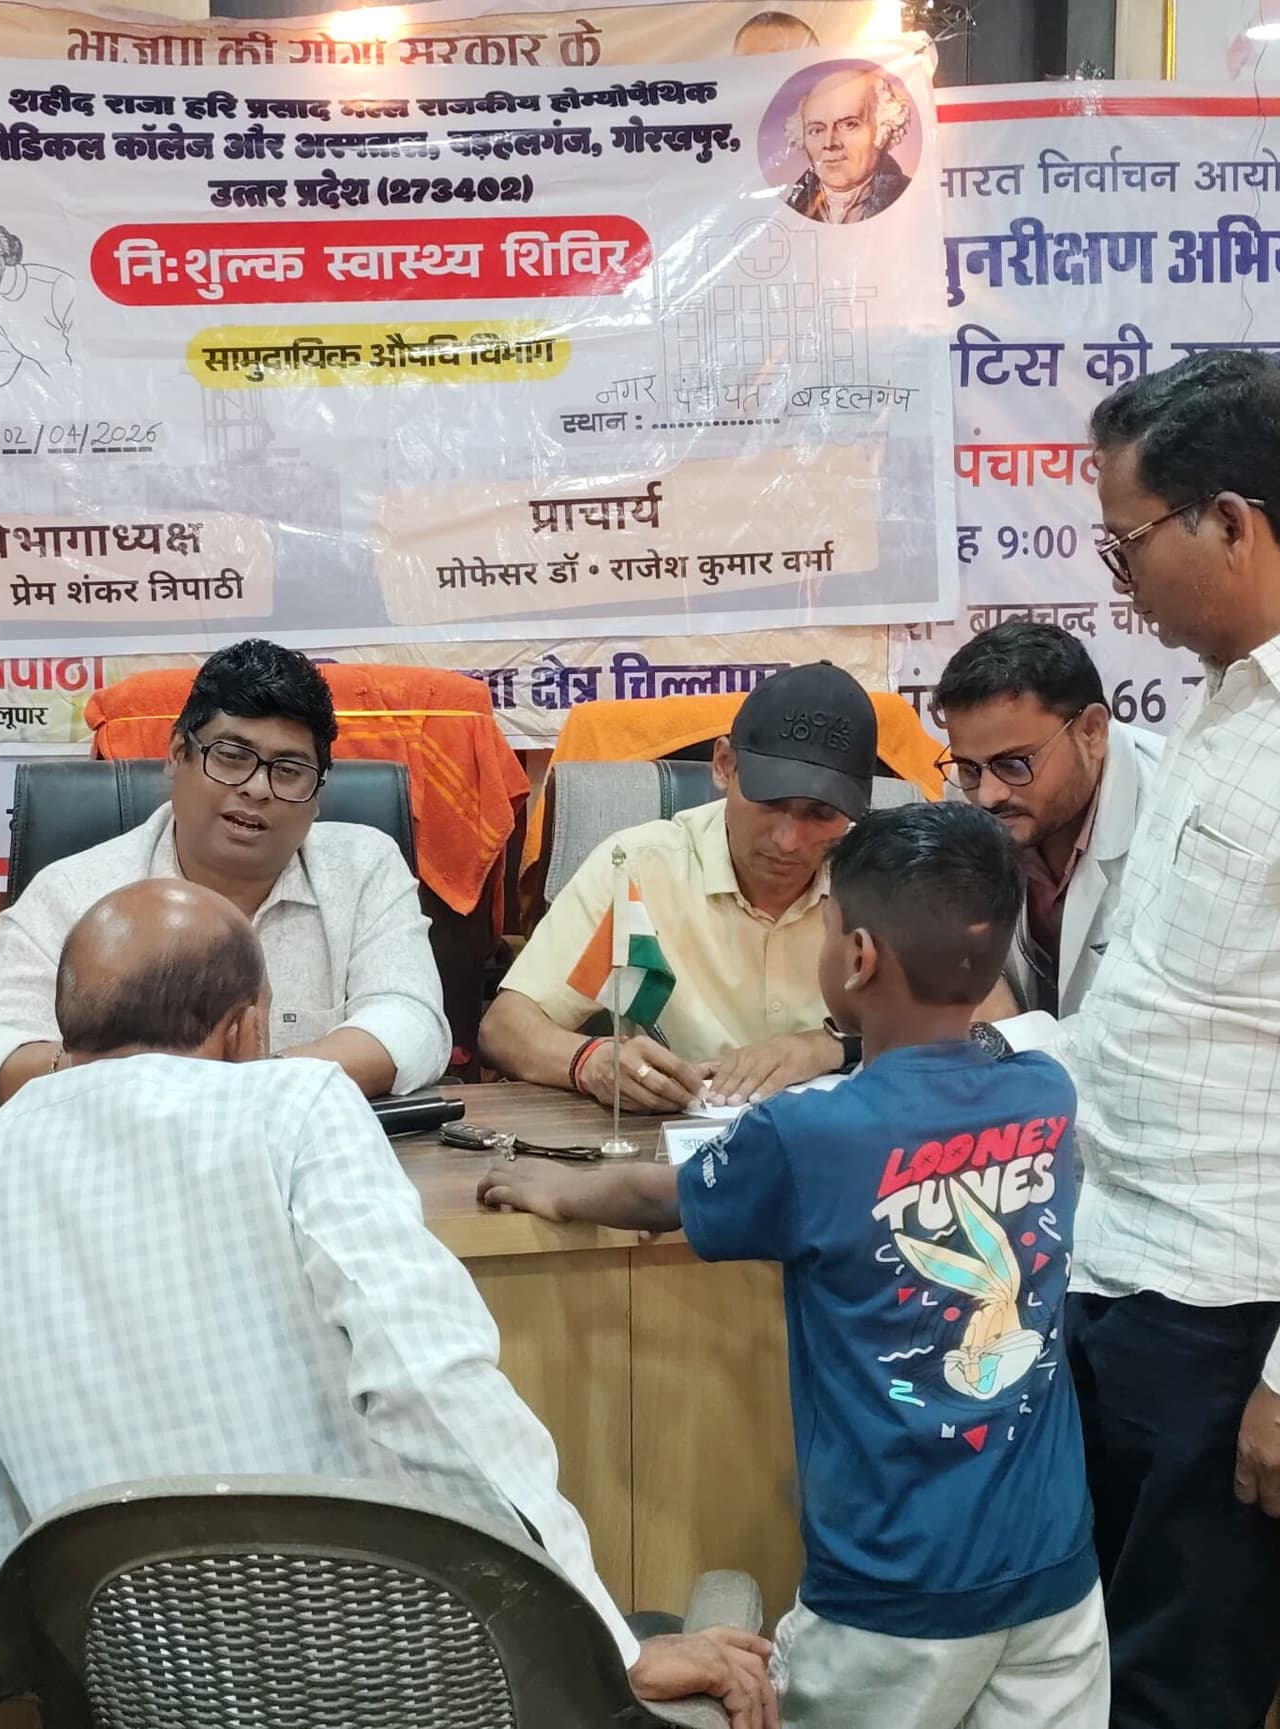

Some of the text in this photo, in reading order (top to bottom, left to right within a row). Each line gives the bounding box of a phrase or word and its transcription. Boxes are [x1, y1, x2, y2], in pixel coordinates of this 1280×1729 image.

[558, 18, 604, 67] के
[8, 84, 95, 116] शहीद
[103, 94, 175, 116] राजा
[183, 90, 238, 120] हरि
[245, 98, 331, 121] प्रसाद
[415, 91, 541, 117] राजकीय
[112, 123, 214, 161] कॉलेज
[224, 123, 285, 159] और
[610, 115, 741, 163] गोरखपुर,
[208, 168, 533, 209] उत्तर प्रदेश (273402)
[940, 163, 1023, 198] ारत
[1038, 146, 1180, 195] निर्वाचन
[324, 240, 484, 283] स्वास्थ्य
[504, 231, 629, 279] शिविर
[202, 337, 362, 383] सामुदायिक
[951, 324, 1063, 389] टिस
[1084, 323, 1153, 388] की
[596, 375, 657, 405] नगर
[529, 480, 663, 534] प्राचार्य
[437, 541, 836, 591] प्रोफेसर डॉ राजेश कुमार वर्मा
[997, 524, 1078, 561] 9:00
[10, 576, 56, 607] प्रेम
[67, 575, 138, 605] शंकर
[148, 568, 244, 602] त्रिपाठी
[877, 1115, 1068, 1199] LOONEY
[871, 1152, 1056, 1231] TUNES
